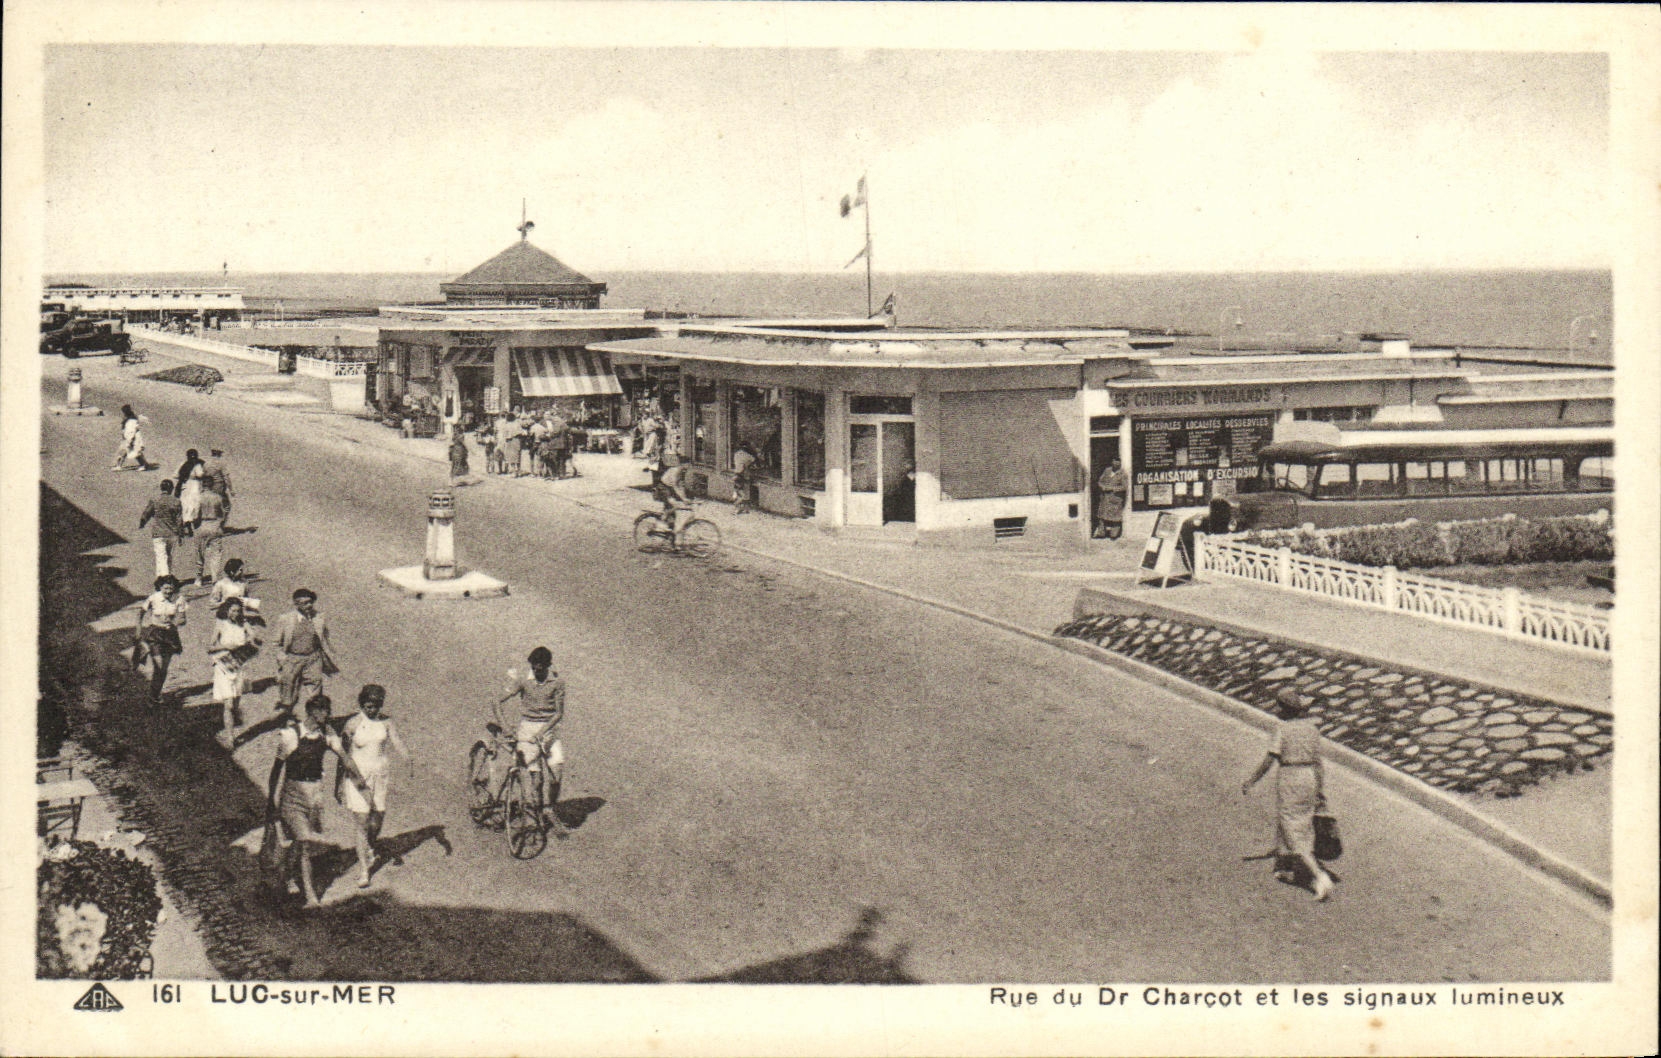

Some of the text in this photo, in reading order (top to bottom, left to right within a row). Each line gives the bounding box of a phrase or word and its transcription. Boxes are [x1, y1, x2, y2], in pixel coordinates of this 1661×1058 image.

[1134, 390, 1198, 407] COURRIERS
[1202, 387, 1271, 405] NORMANDS
[1135, 420, 1182, 432] PRINCIPALES
[1225, 417, 1269, 428] DESSERVIES
[1136, 466, 1259, 485] ORGANISATION D'EXCURSIO
